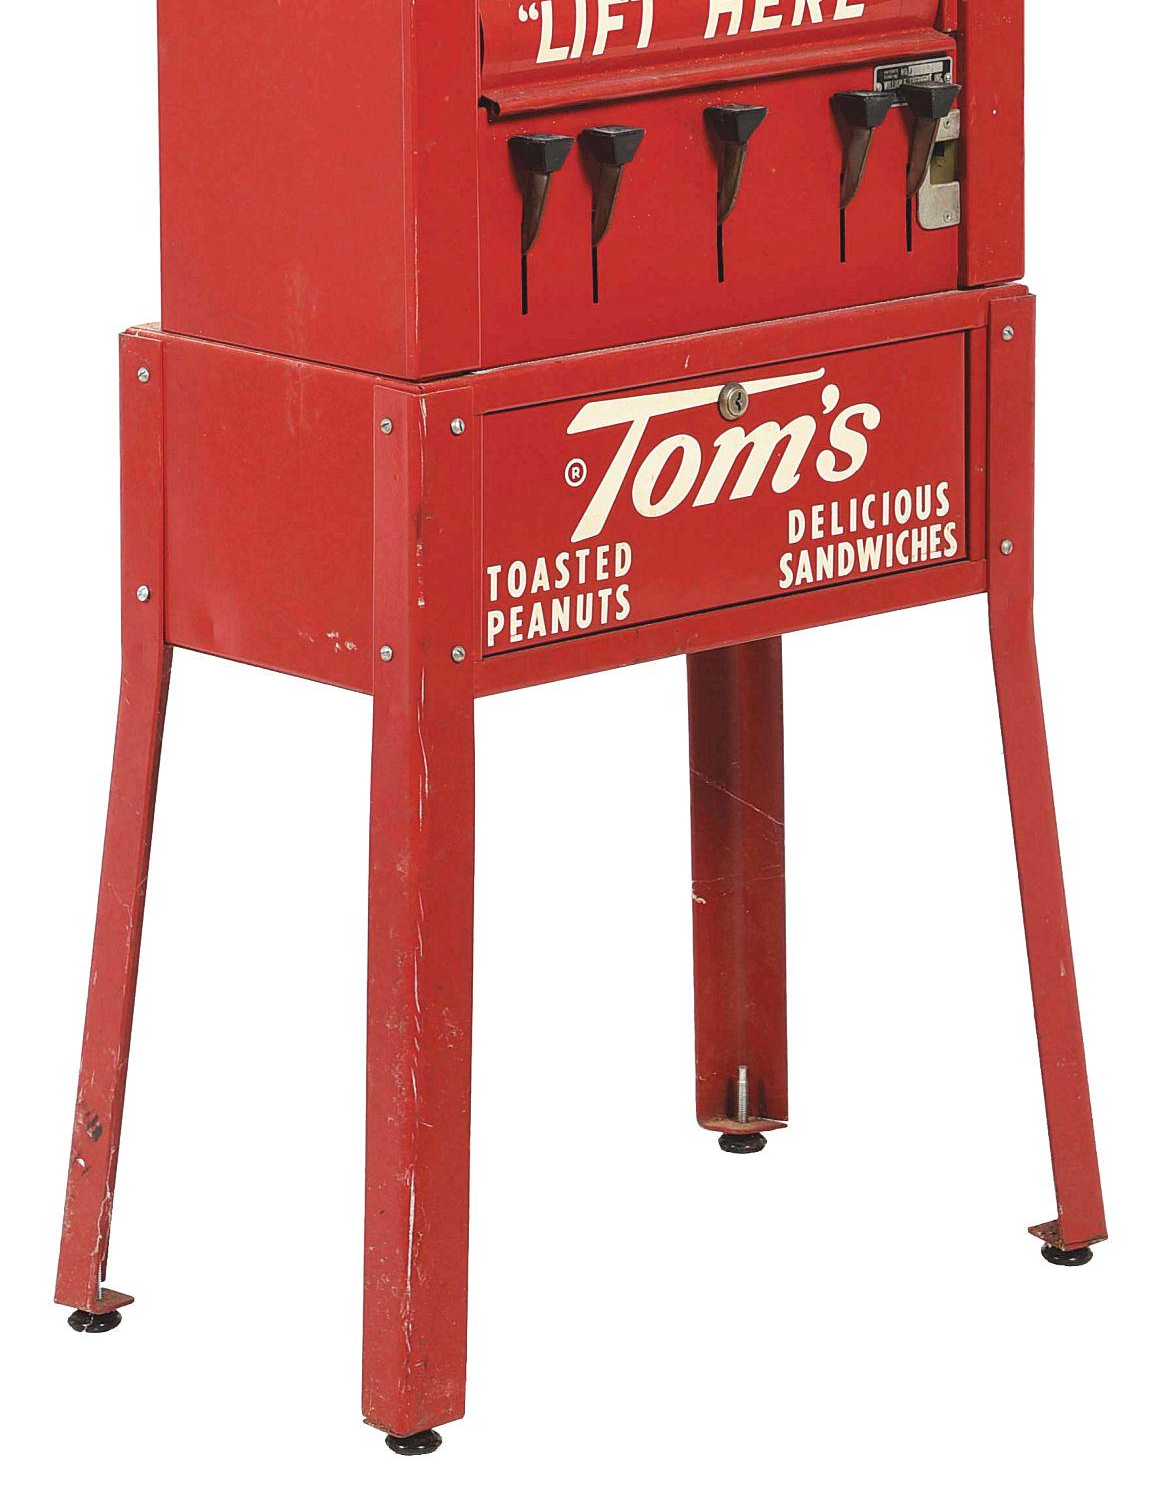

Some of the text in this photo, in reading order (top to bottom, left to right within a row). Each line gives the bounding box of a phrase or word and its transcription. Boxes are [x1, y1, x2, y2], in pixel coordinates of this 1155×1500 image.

[566, 367, 881, 543] Tom's
[788, 481, 950, 544] DELICIOUS
[486, 541, 632, 602] TOASTED
[779, 521, 958, 589] SANDWICHES
[487, 583, 631, 647] PEANUTS
